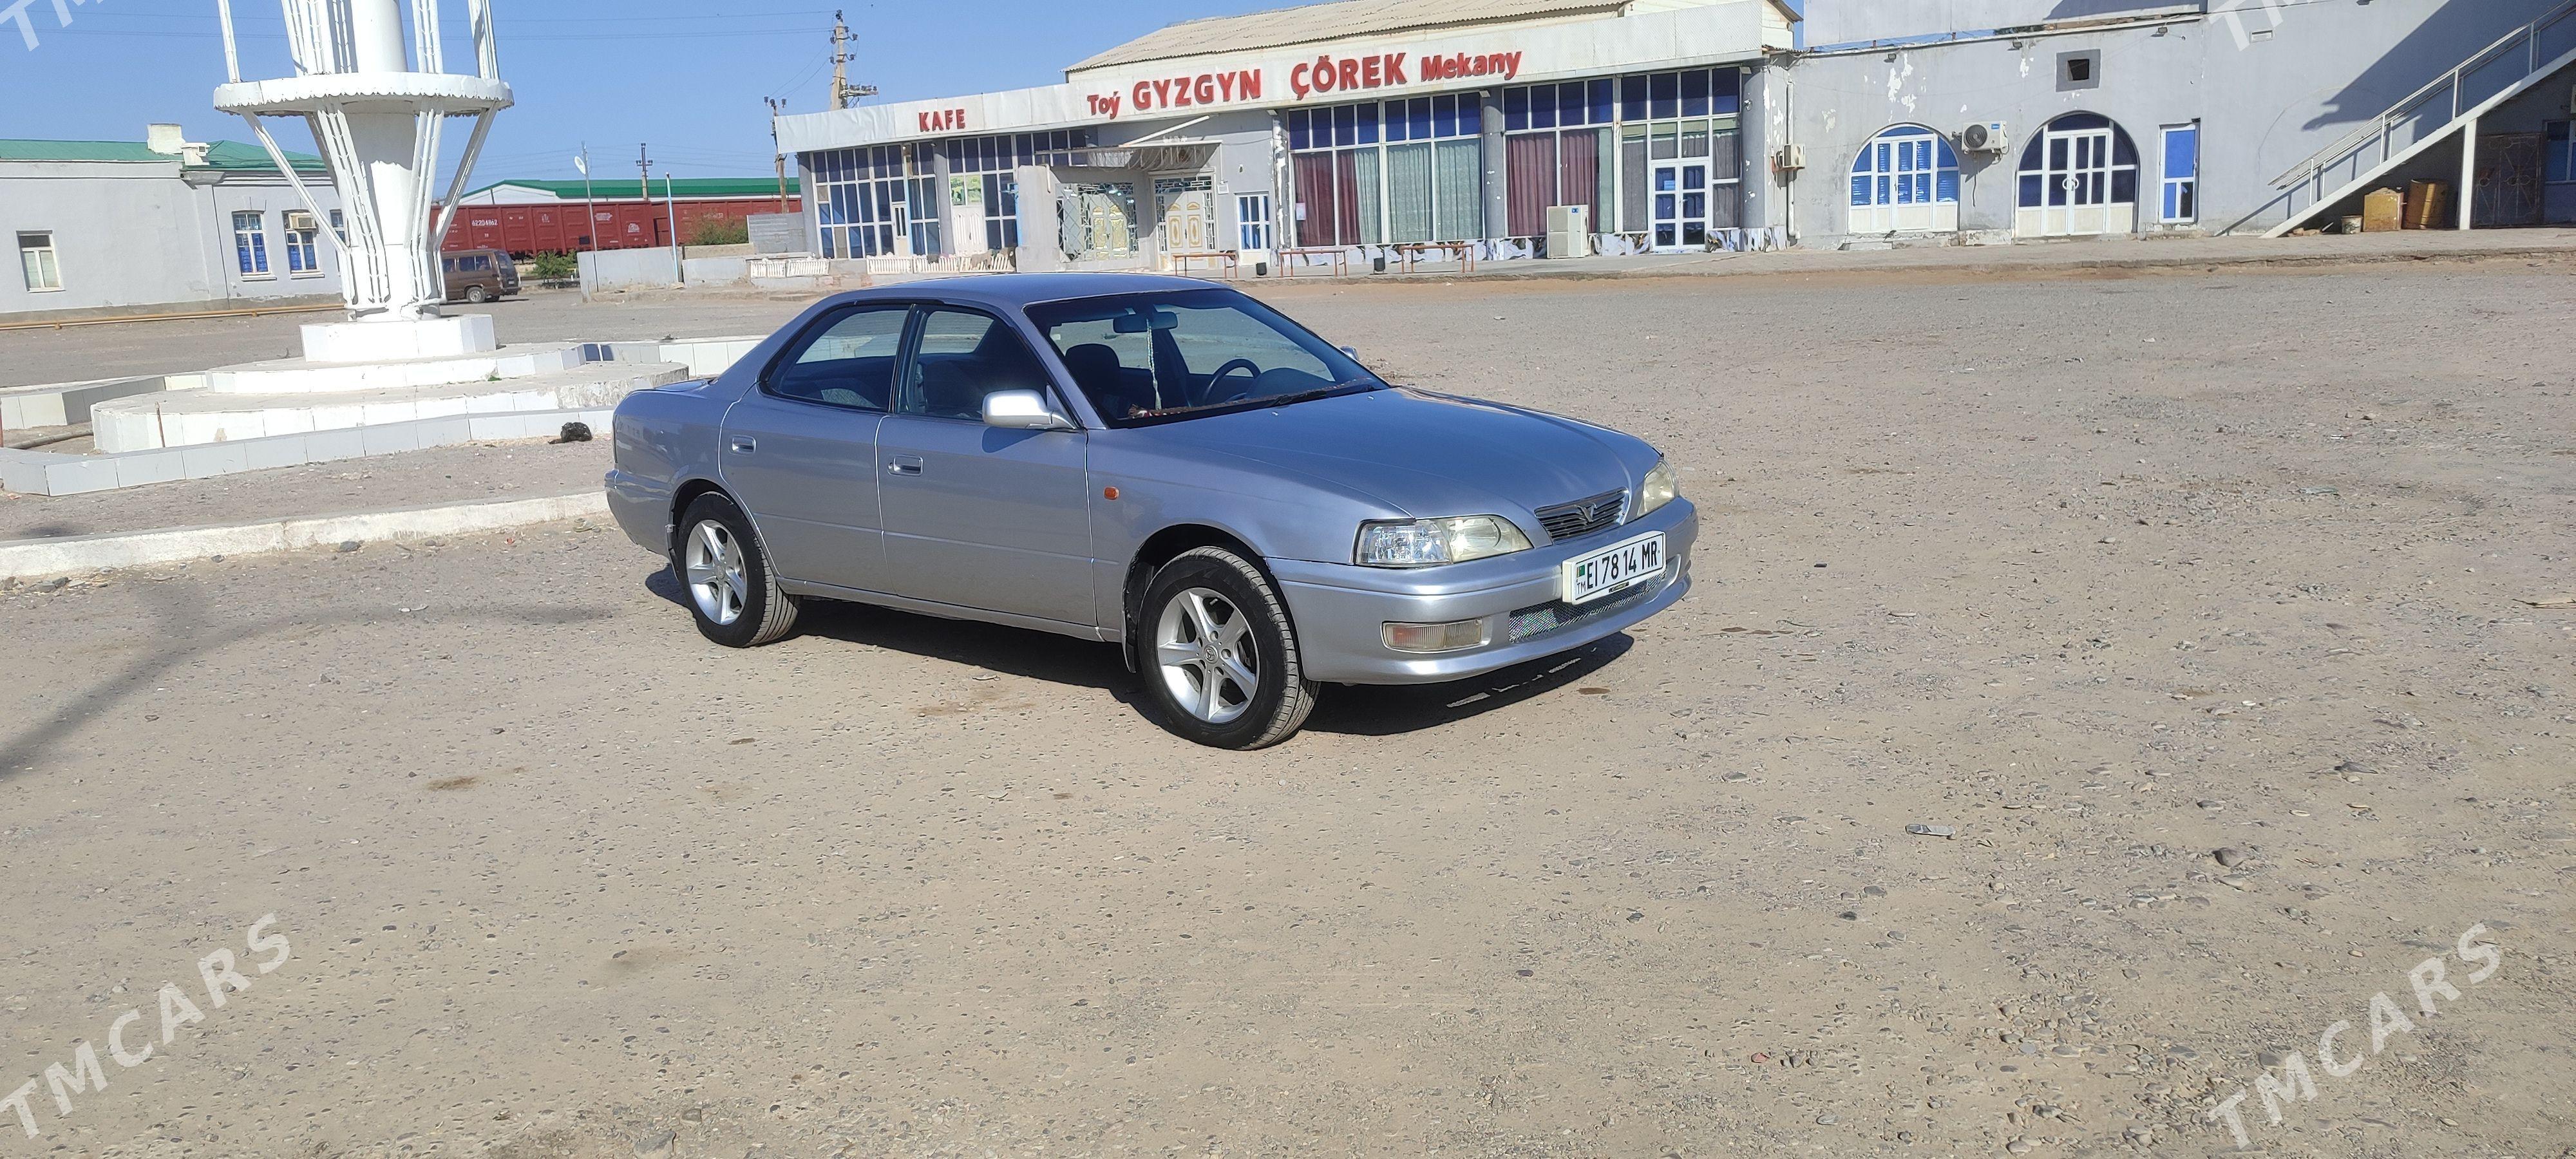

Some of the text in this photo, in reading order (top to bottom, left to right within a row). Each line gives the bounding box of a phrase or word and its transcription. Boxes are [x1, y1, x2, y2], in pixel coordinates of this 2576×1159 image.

[1086, 51, 1522, 120] Toý GYZGYN ÇÖREK Mekany
[918, 109, 965, 132] KAFE
[1587, 540, 1658, 589] EI 78 14 MR
